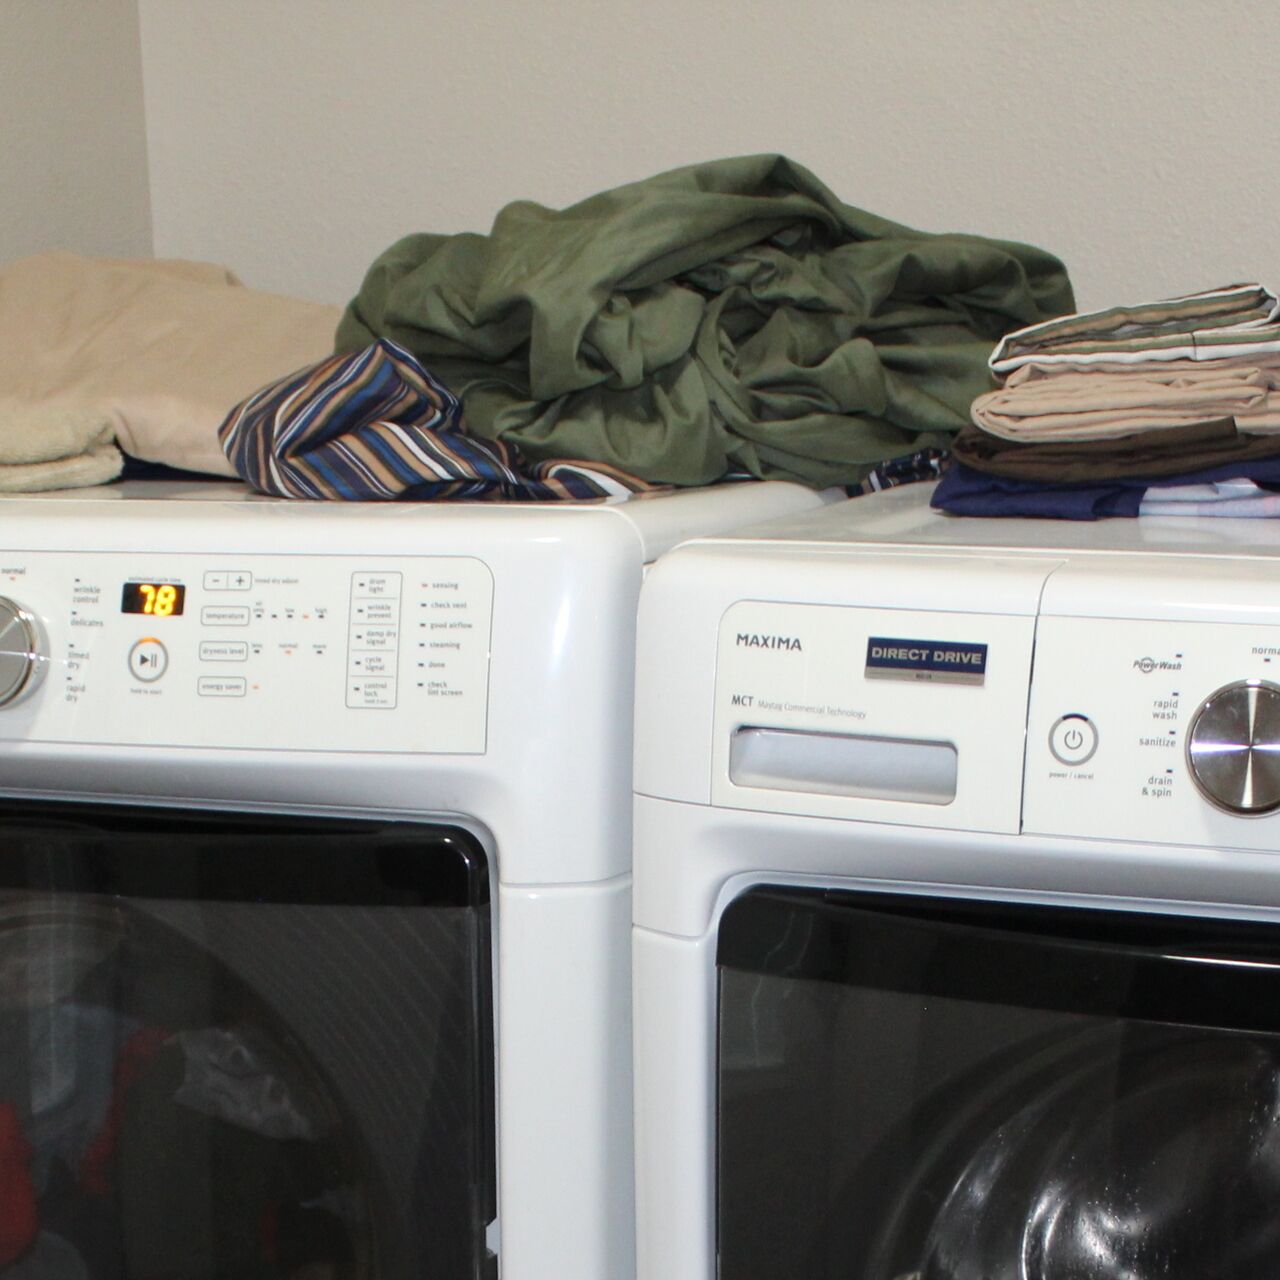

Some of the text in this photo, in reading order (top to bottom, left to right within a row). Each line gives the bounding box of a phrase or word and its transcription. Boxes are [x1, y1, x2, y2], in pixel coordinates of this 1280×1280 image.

[1, 567, 26, 575] normal
[74, 586, 101, 594] wrinkle
[432, 582, 458, 590] sensing
[73, 596, 99, 604] control
[140, 584, 176, 616] 78
[206, 612, 244, 621] temperature
[70, 619, 104, 627] delicates
[429, 642, 460, 650] steaming
[736, 633, 802, 652] MAXIMA
[871, 647, 983, 665] DIRECT DRIVE
[731, 694, 754, 707] MCT
[1153, 699, 1179, 710] rapid
[1152, 710, 1178, 720] wash
[1139, 736, 1176, 747] sanitize
[1049, 771, 1068, 779] power
[1074, 772, 1094, 780] cancel
[1148, 775, 1173, 785] drain
[1141, 786, 1172, 798] & spin
